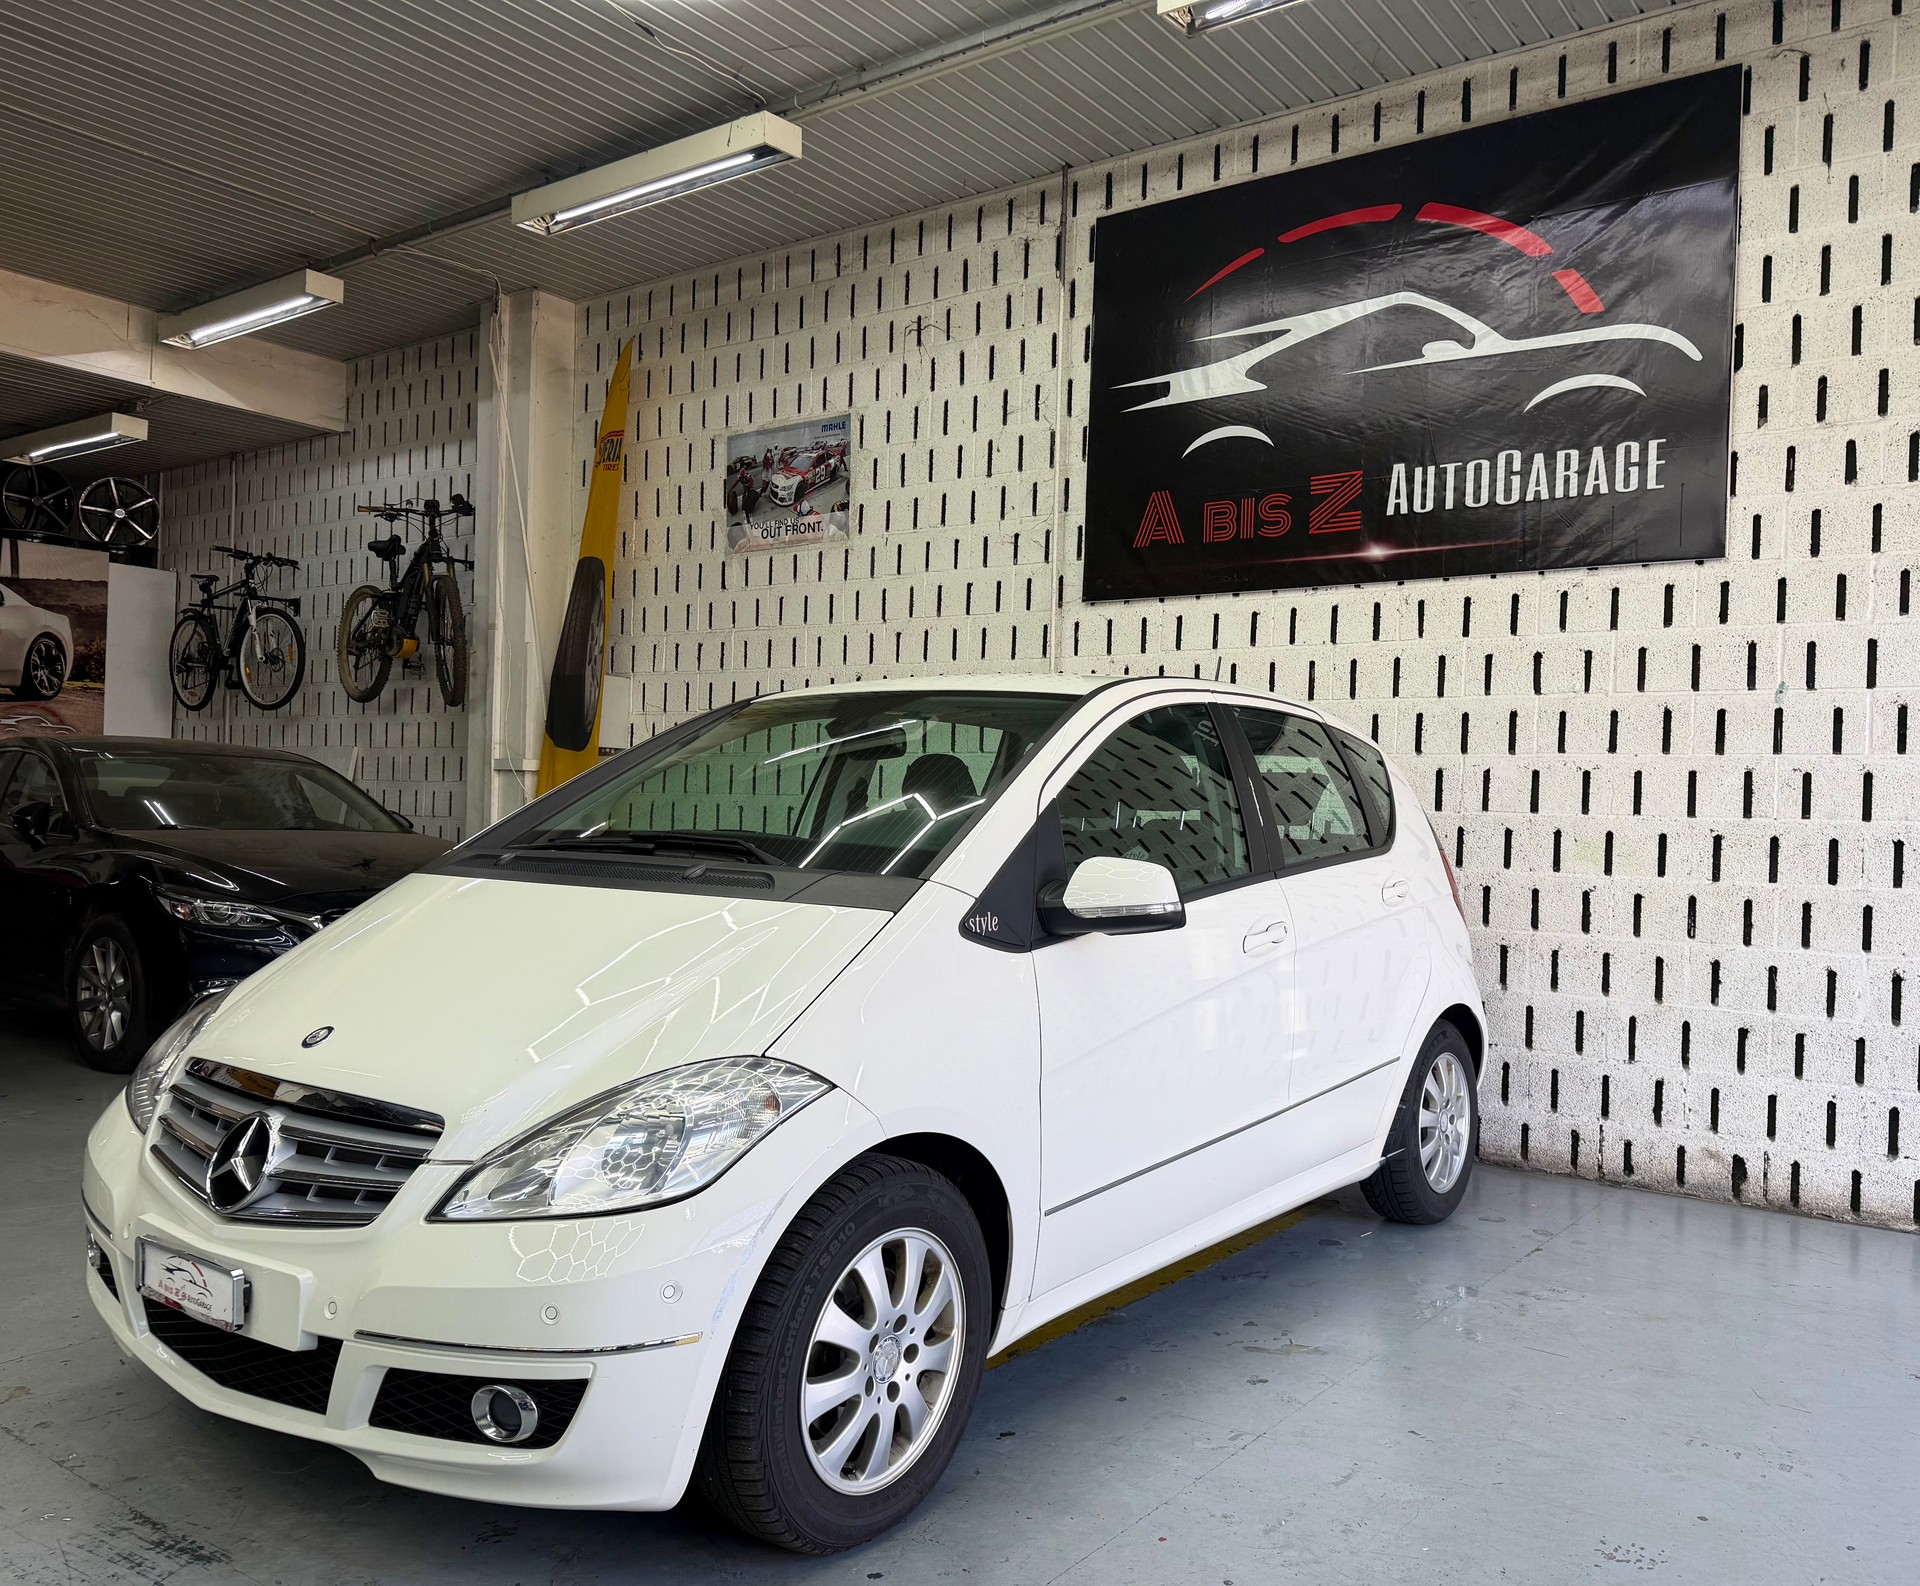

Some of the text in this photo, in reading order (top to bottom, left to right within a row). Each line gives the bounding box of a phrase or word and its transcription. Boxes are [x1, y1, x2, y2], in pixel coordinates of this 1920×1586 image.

[821, 421, 847, 433] MAHLE
[815, 465, 827, 483] 29
[1132, 438, 1668, 548] A BIS Z AUTOGARAGE
[750, 516, 800, 530] YOU'LL FIND US
[761, 520, 824, 540] OUT FRONT.
[969, 911, 999, 936] style
